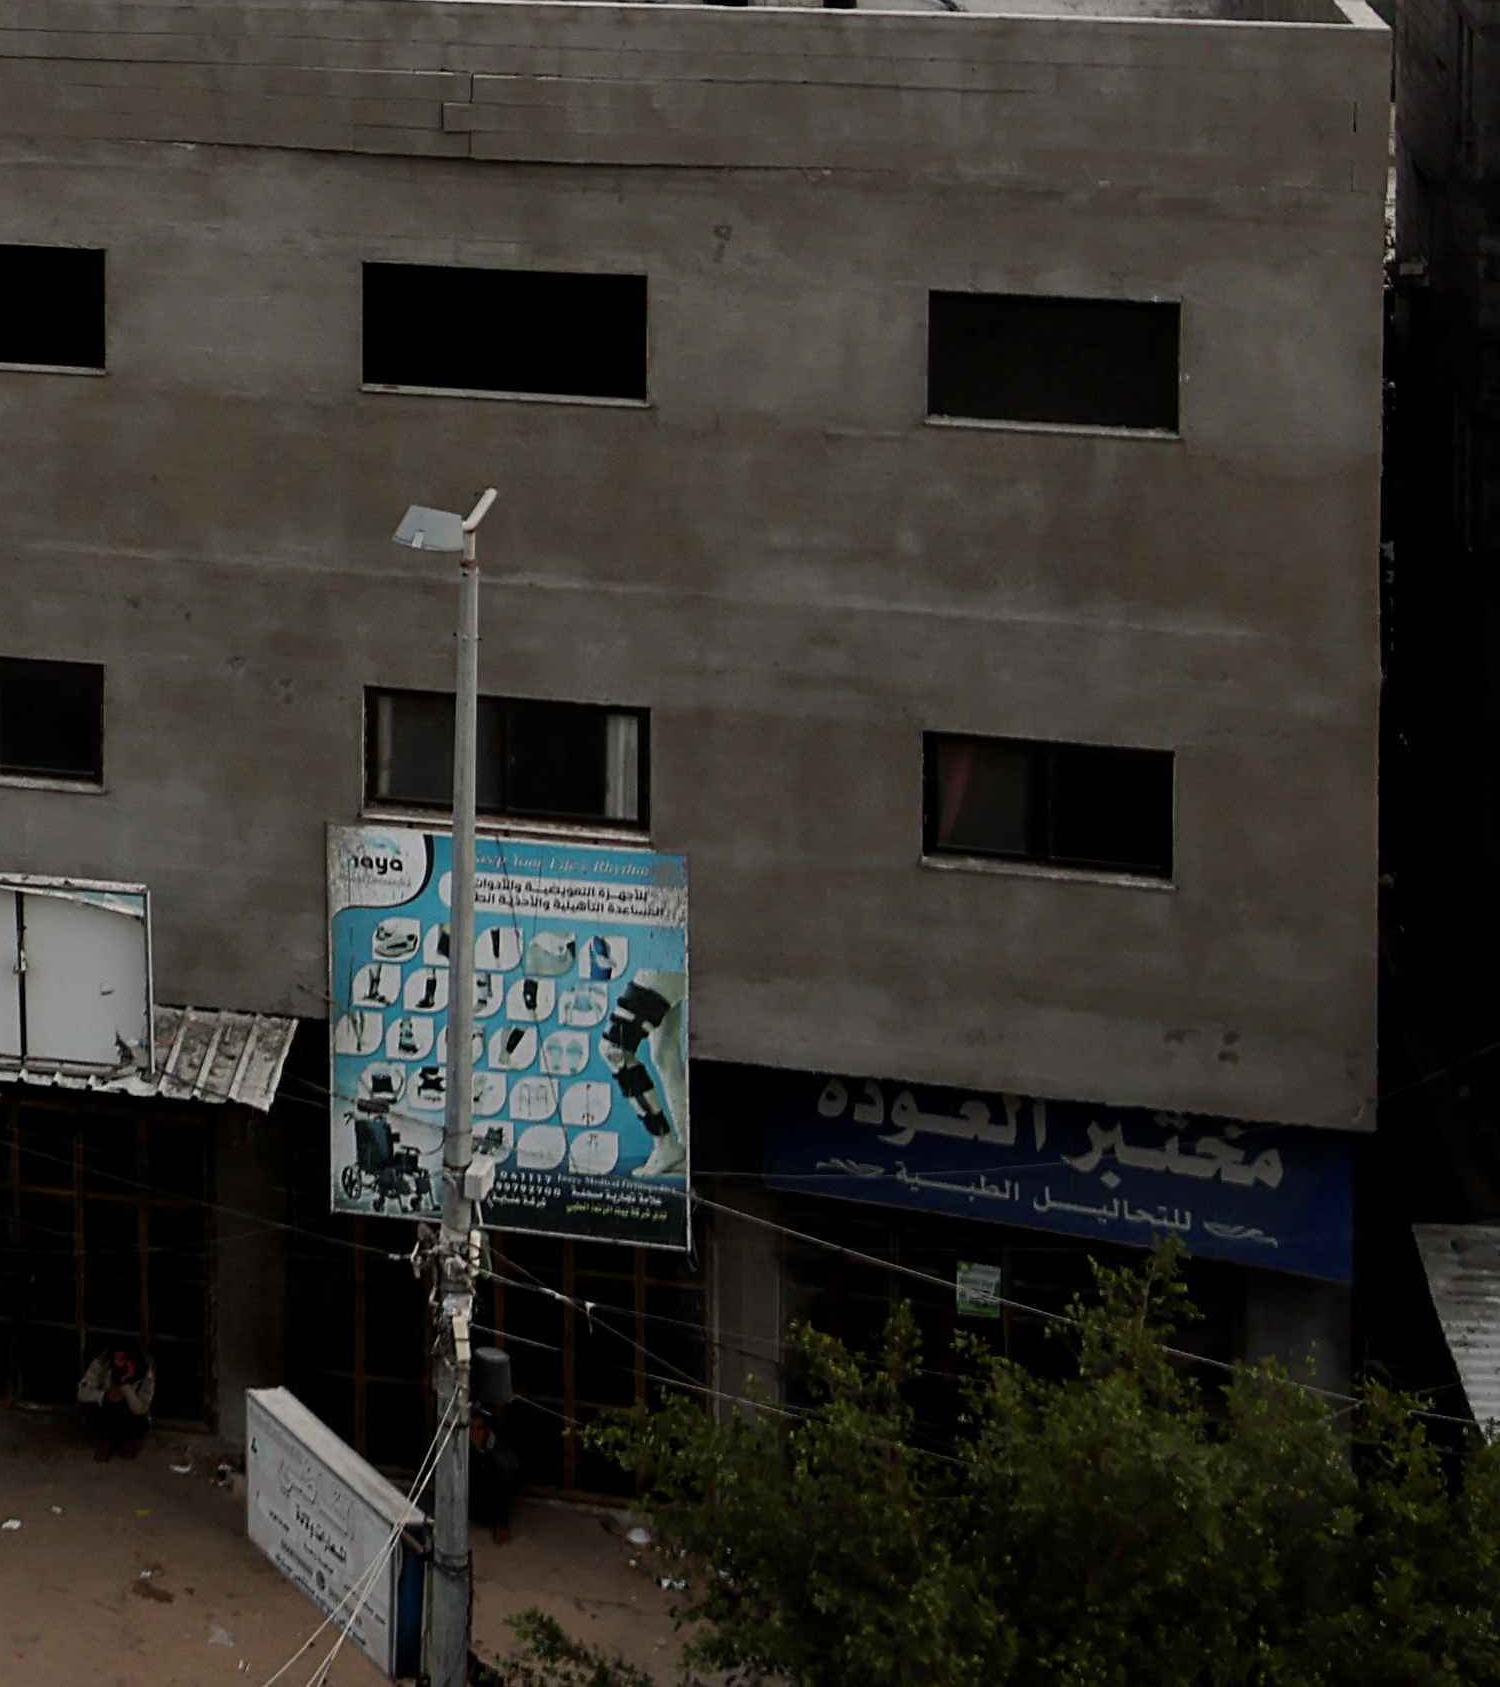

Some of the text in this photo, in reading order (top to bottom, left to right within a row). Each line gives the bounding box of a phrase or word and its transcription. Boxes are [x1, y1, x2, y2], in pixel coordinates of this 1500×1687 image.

[1062, 1109, 1285, 1189] مختبر
[895, 1160, 1192, 1232] للتحاليل الطبية
